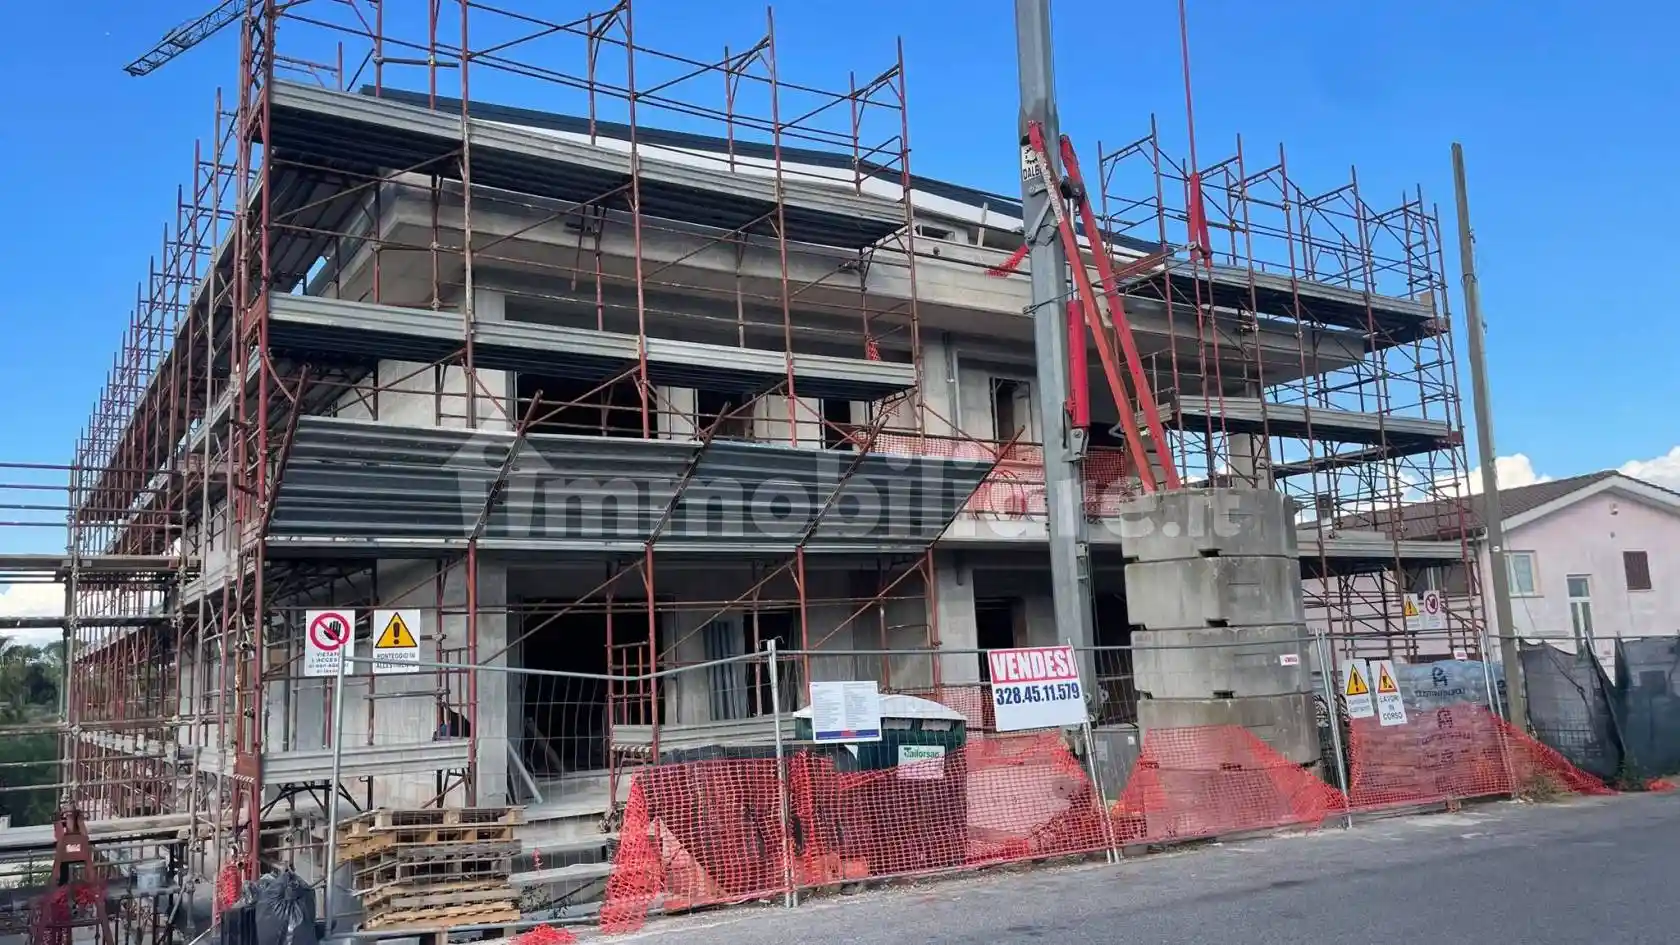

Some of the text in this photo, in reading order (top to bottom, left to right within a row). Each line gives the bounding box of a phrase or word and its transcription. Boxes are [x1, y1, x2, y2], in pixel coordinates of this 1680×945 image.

[991, 648, 1077, 681] VENDESI
[995, 682, 1080, 706] 328.45.11.579
[1382, 711, 1403, 720] CORSO
